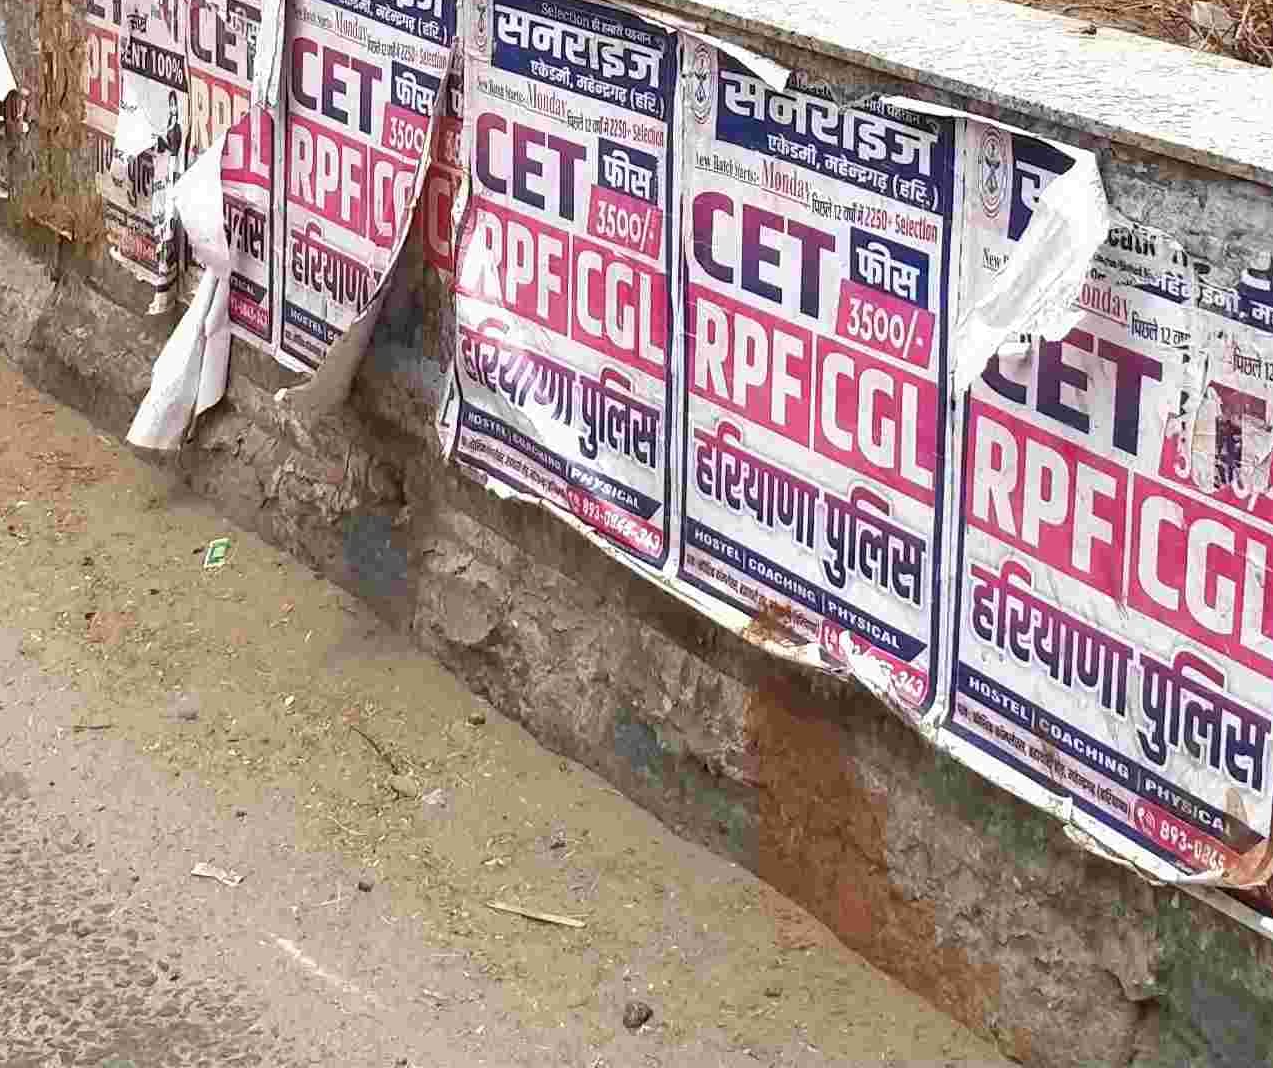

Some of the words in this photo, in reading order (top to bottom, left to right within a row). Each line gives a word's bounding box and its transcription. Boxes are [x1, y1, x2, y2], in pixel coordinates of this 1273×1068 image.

[291, 36, 383, 136] CET
[495, 3, 665, 88] सनराइज
[527, 82, 569, 118] Monday
[719, 69, 940, 176] सनराइज
[288, 125, 364, 222] RPF
[477, 112, 587, 222] CET
[602, 150, 654, 200] फीस
[760, 159, 816, 201] Monday
[459, 211, 565, 321] RPF
[576, 251, 665, 365] CGL
[691, 190, 836, 319] CET
[855, 243, 920, 300] फीस
[1081, 285, 1128, 323] onday
[846, 297, 926, 360] 3500/-
[579, 367, 661, 468] पुलिस
[694, 298, 806, 427] RPF
[821, 351, 935, 489] CGL
[692, 420, 820, 553] हरियाणा
[822, 486, 928, 607] पुलिस
[971, 415, 1119, 575] RPF
[693, 529, 743, 562] HOSTEL
[748, 557, 818, 603] COACHING
[828, 599, 901, 650] PHYSICAL
[969, 559, 1134, 719] हरियाणा
[1137, 651, 1273, 792] पुलिस
[969, 675, 1031, 722] HOSTEL
[1039, 718, 1131, 780] COACHING
